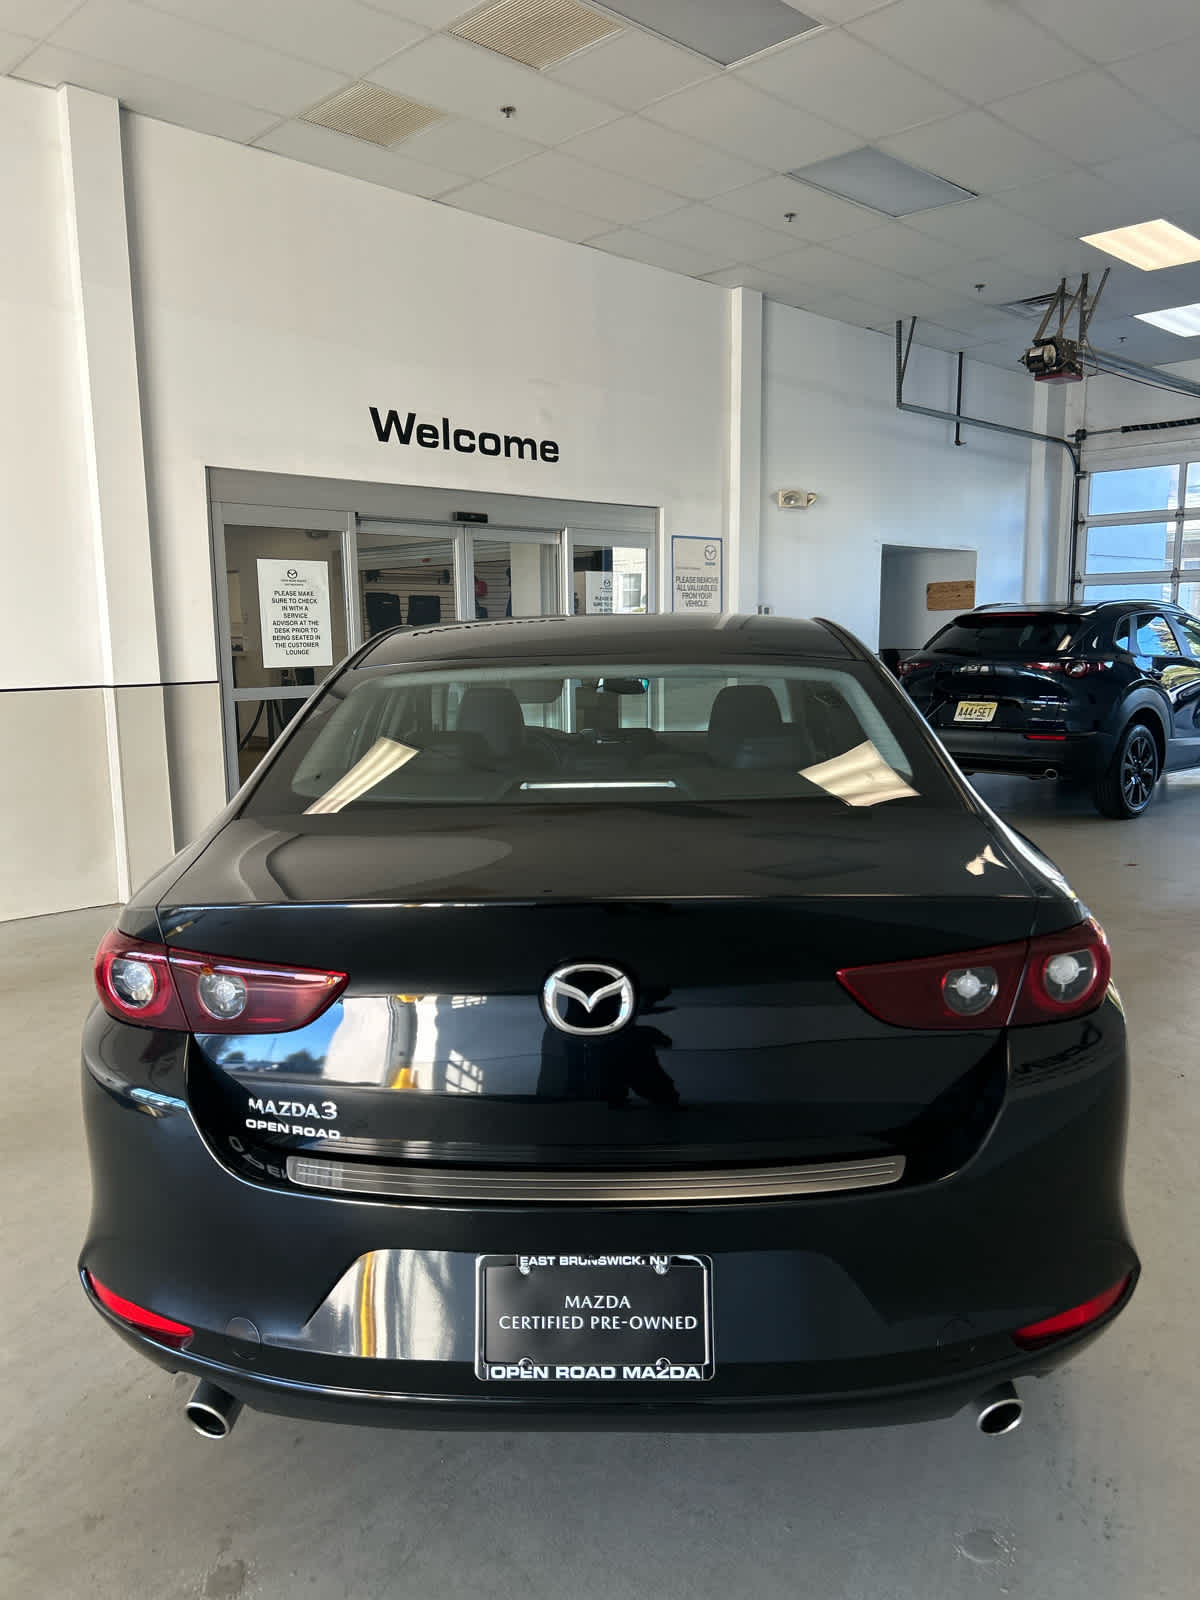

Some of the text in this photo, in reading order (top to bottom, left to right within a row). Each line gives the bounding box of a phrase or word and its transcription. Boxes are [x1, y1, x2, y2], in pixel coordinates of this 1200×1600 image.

[369, 406, 560, 463] Welcome
[676, 584, 686, 592] ALL
[698, 592, 712, 600] YOUR
[248, 1097, 338, 1120] MAZDA3
[245, 1118, 341, 1140] OPEN ROAD
[520, 1256, 555, 1266] EAST
[649, 1256, 669, 1266] NJ
[564, 1295, 631, 1310] MAZDA
[498, 1315, 698, 1330] CERTIFIED PRE-OWNED
[490, 1366, 701, 1380] OPEN ROAD MAZDA
